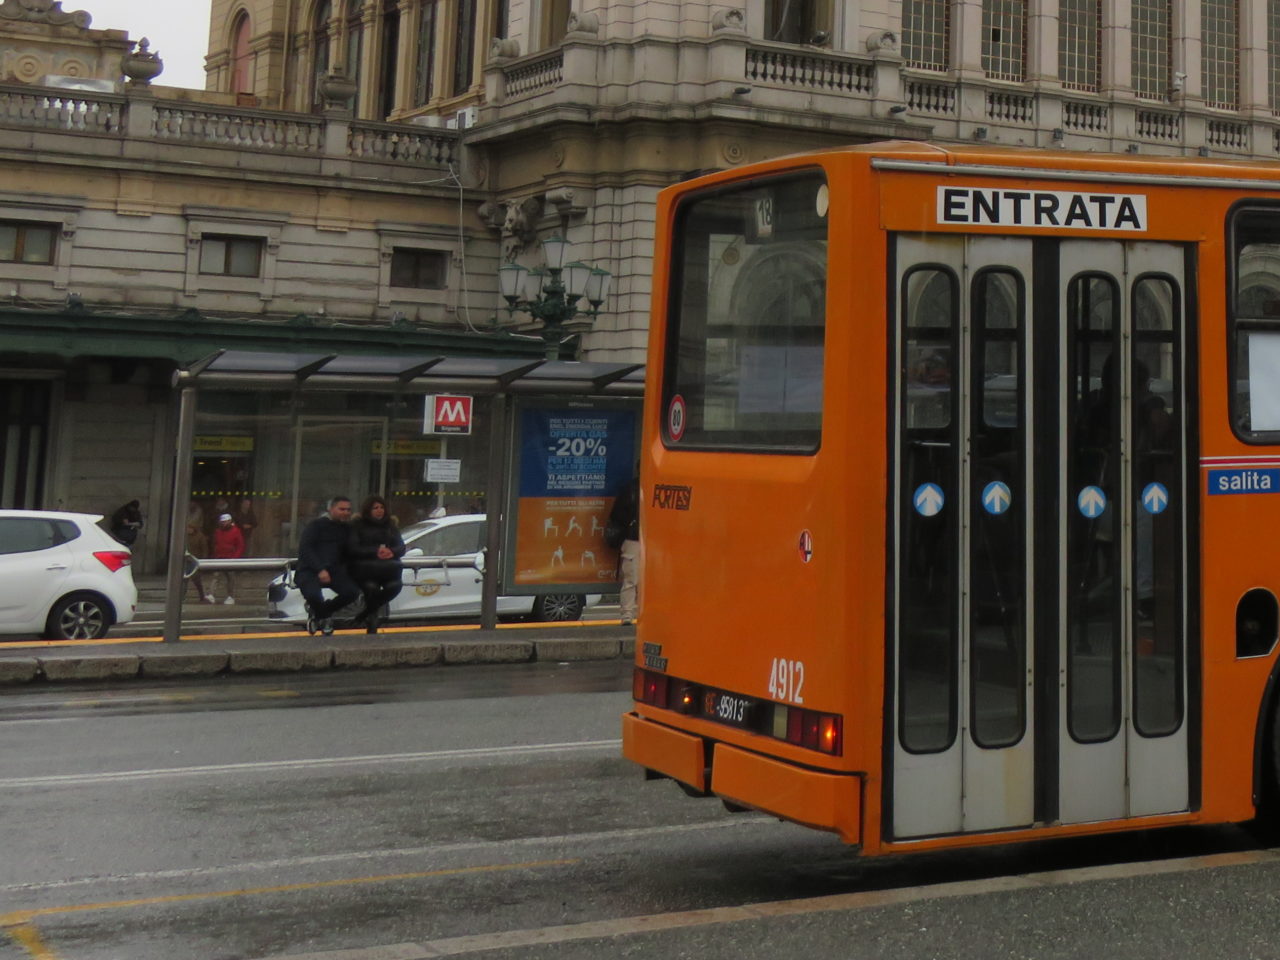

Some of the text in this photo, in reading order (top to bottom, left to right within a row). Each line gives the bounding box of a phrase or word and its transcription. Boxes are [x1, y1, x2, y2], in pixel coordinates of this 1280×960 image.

[758, 199, 772, 226] 18
[944, 188, 1141, 229] ENTRATA
[672, 408, 681, 427] 80
[548, 438, 607, 456] -20%
[1218, 471, 1271, 491] salita
[768, 657, 804, 704] 4912
